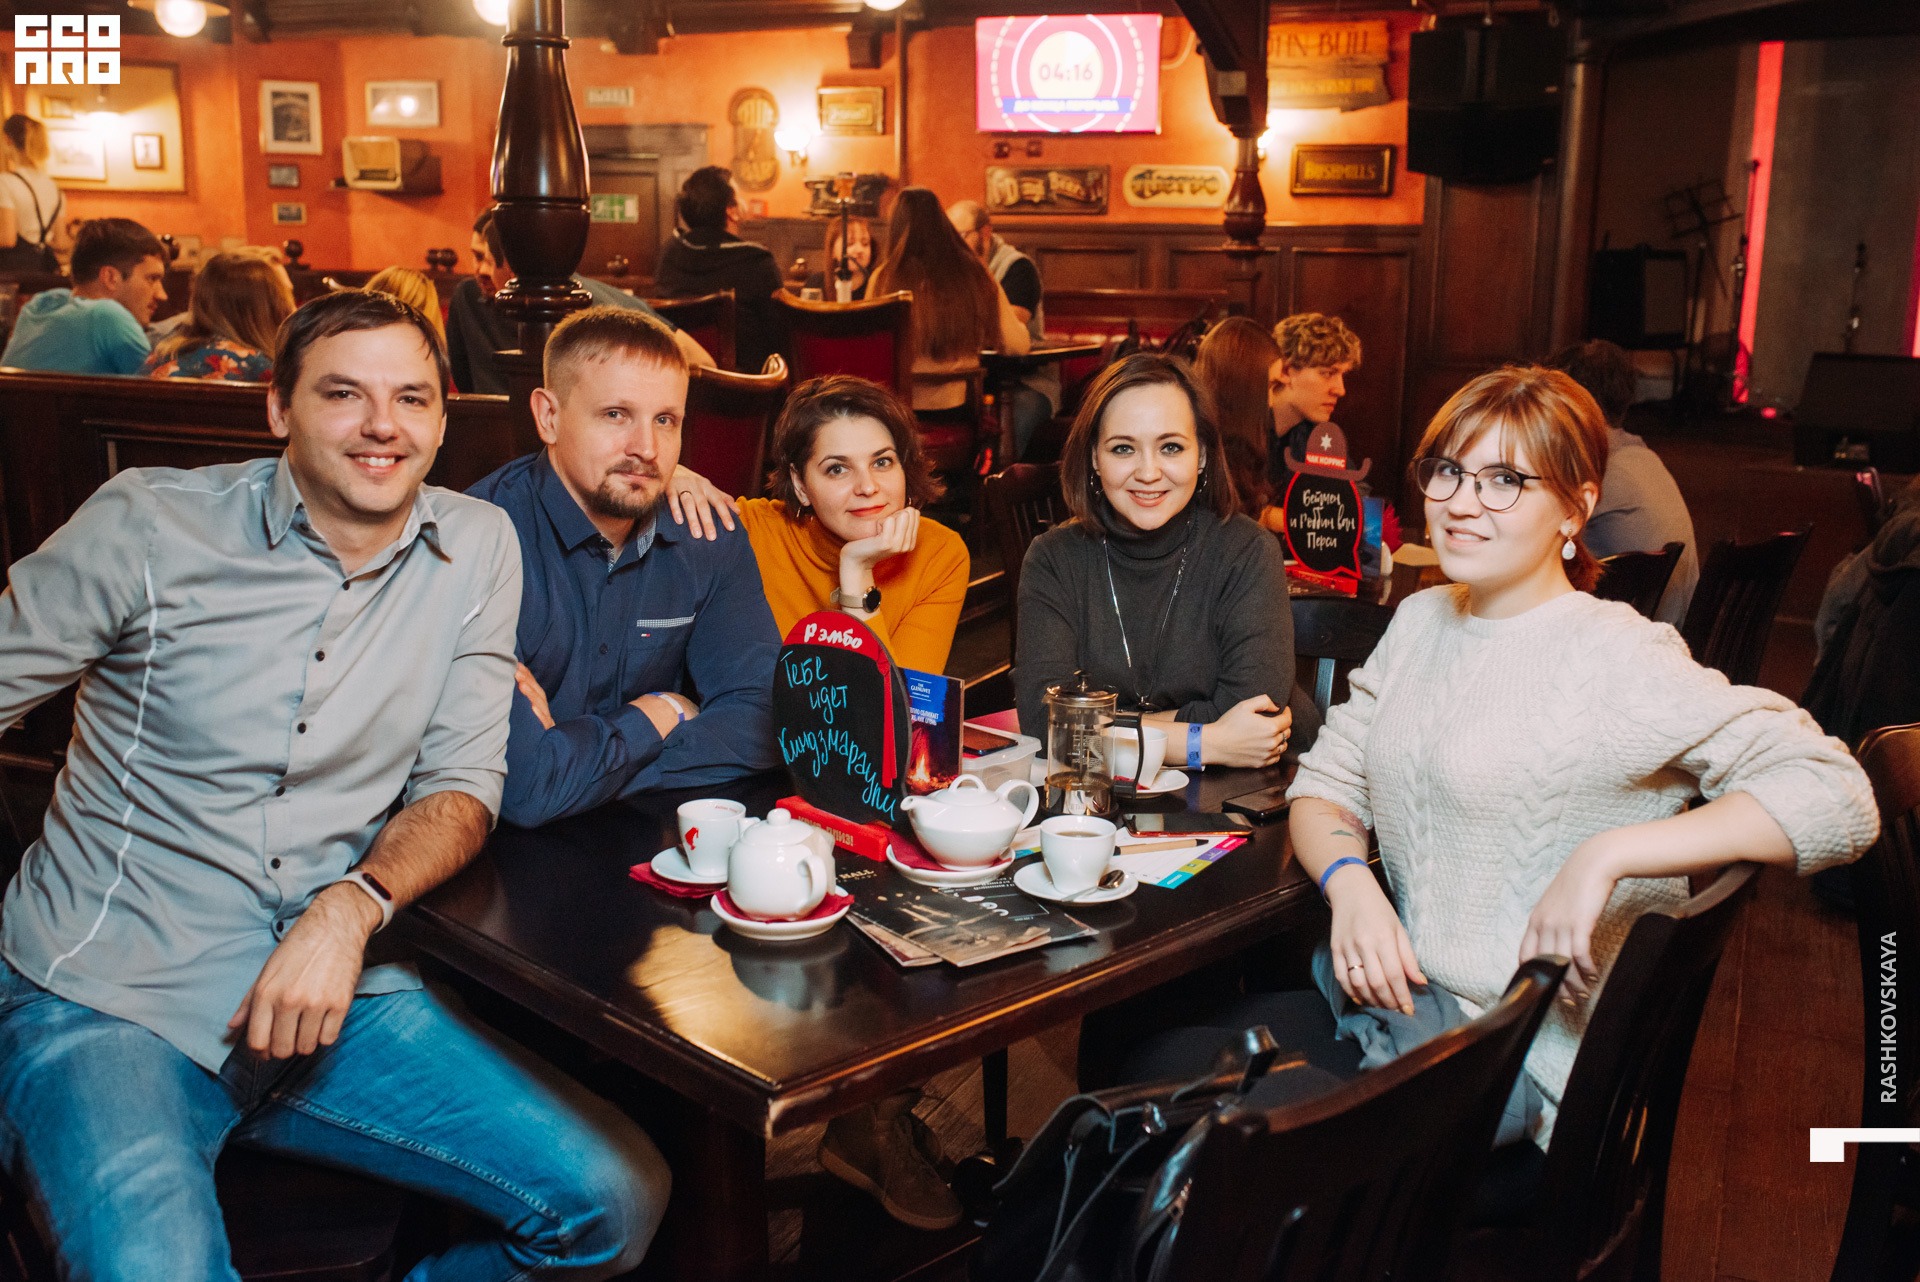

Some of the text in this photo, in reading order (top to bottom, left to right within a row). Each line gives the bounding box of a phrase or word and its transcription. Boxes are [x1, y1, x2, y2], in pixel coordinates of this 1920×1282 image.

[1319, 30, 1371, 56] BULL
[1038, 63, 1093, 81] 04:16
[1304, 161, 1376, 180] BUSHMILLS
[1306, 454, 1345, 468] ЧАК НОРРИС
[1290, 518, 1297, 528] и
[804, 623, 863, 649] Рэмбо
[781, 650, 828, 689] Тебе
